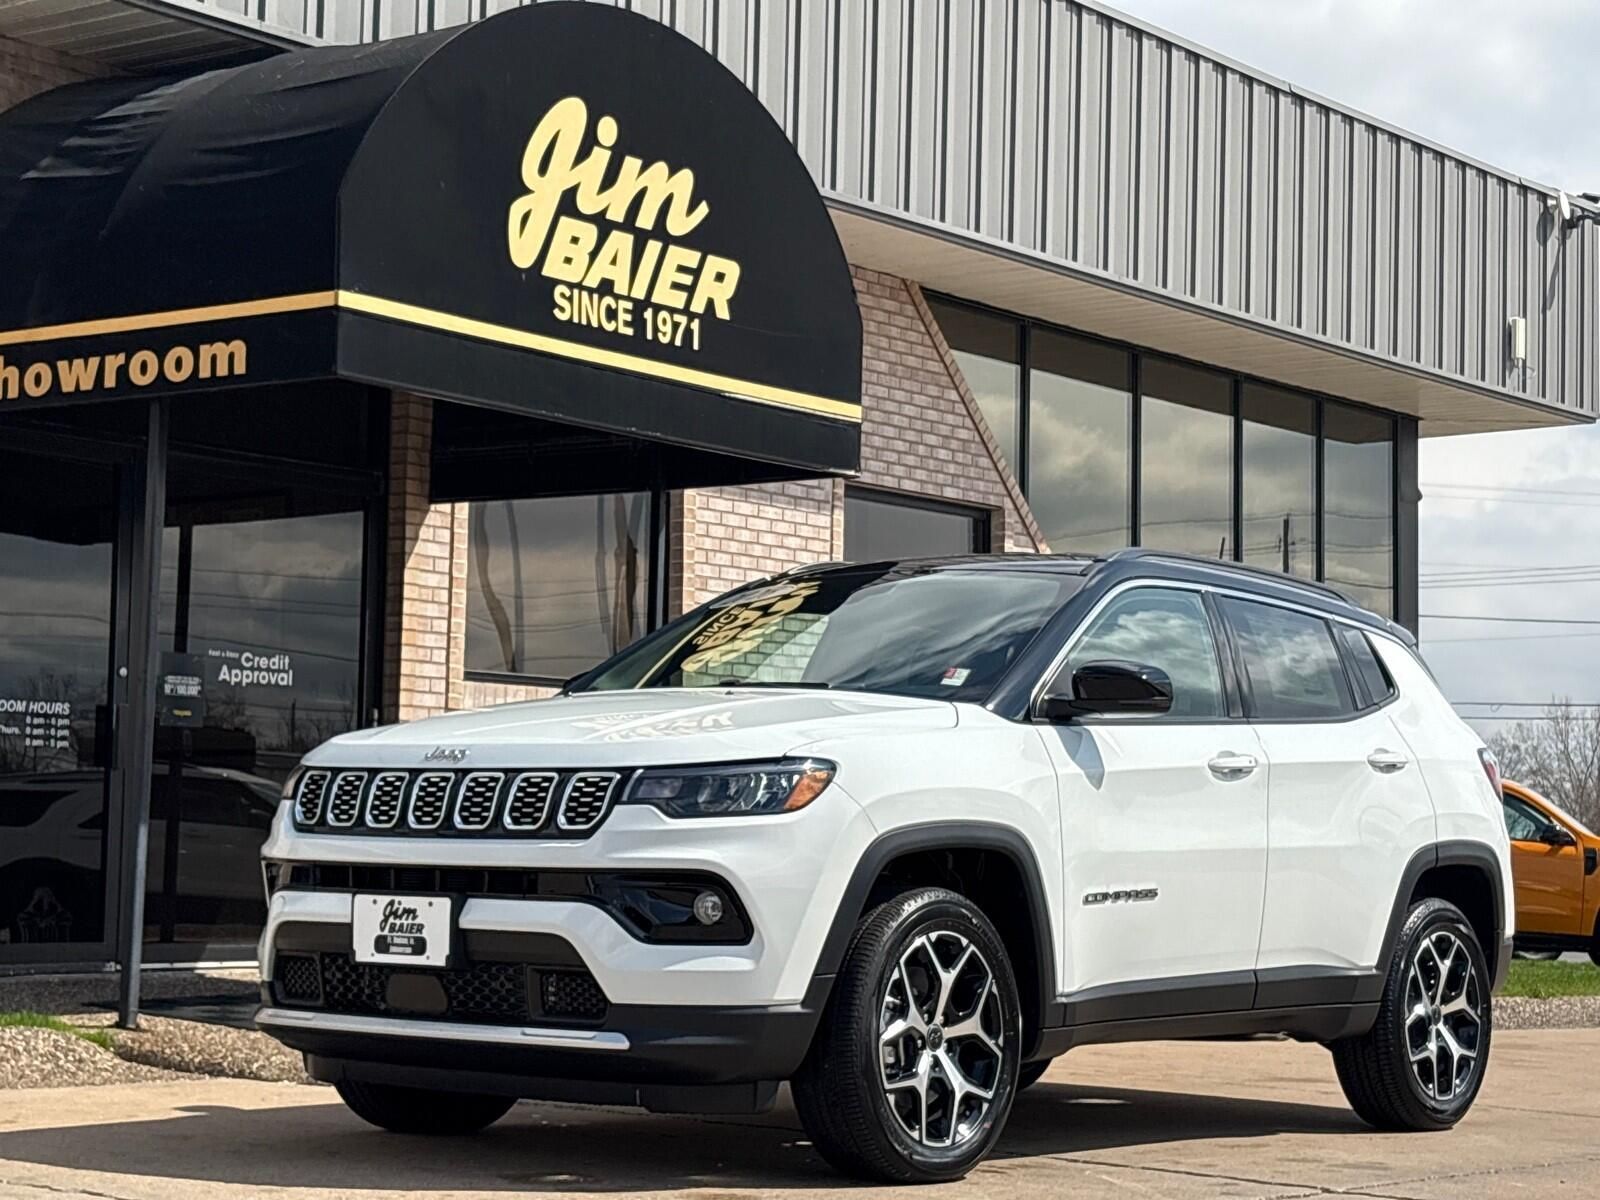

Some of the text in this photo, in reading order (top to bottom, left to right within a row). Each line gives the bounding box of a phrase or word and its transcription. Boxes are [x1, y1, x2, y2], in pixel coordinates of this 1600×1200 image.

[508, 96, 709, 269] Jim
[541, 215, 740, 321] BAIER
[552, 283, 701, 351] SINCE 1971
[0, 339, 247, 400] howroom
[241, 652, 290, 670] Credit
[218, 664, 293, 687] Approval
[29, 701, 70, 715] HOURS
[57, 718, 70, 727] pm
[57, 729, 69, 738] pm
[424, 745, 469, 764] Jeep
[1082, 887, 1158, 905] COMPASS
[380, 899, 418, 932] Jim
[388, 922, 424, 934] BAIER
